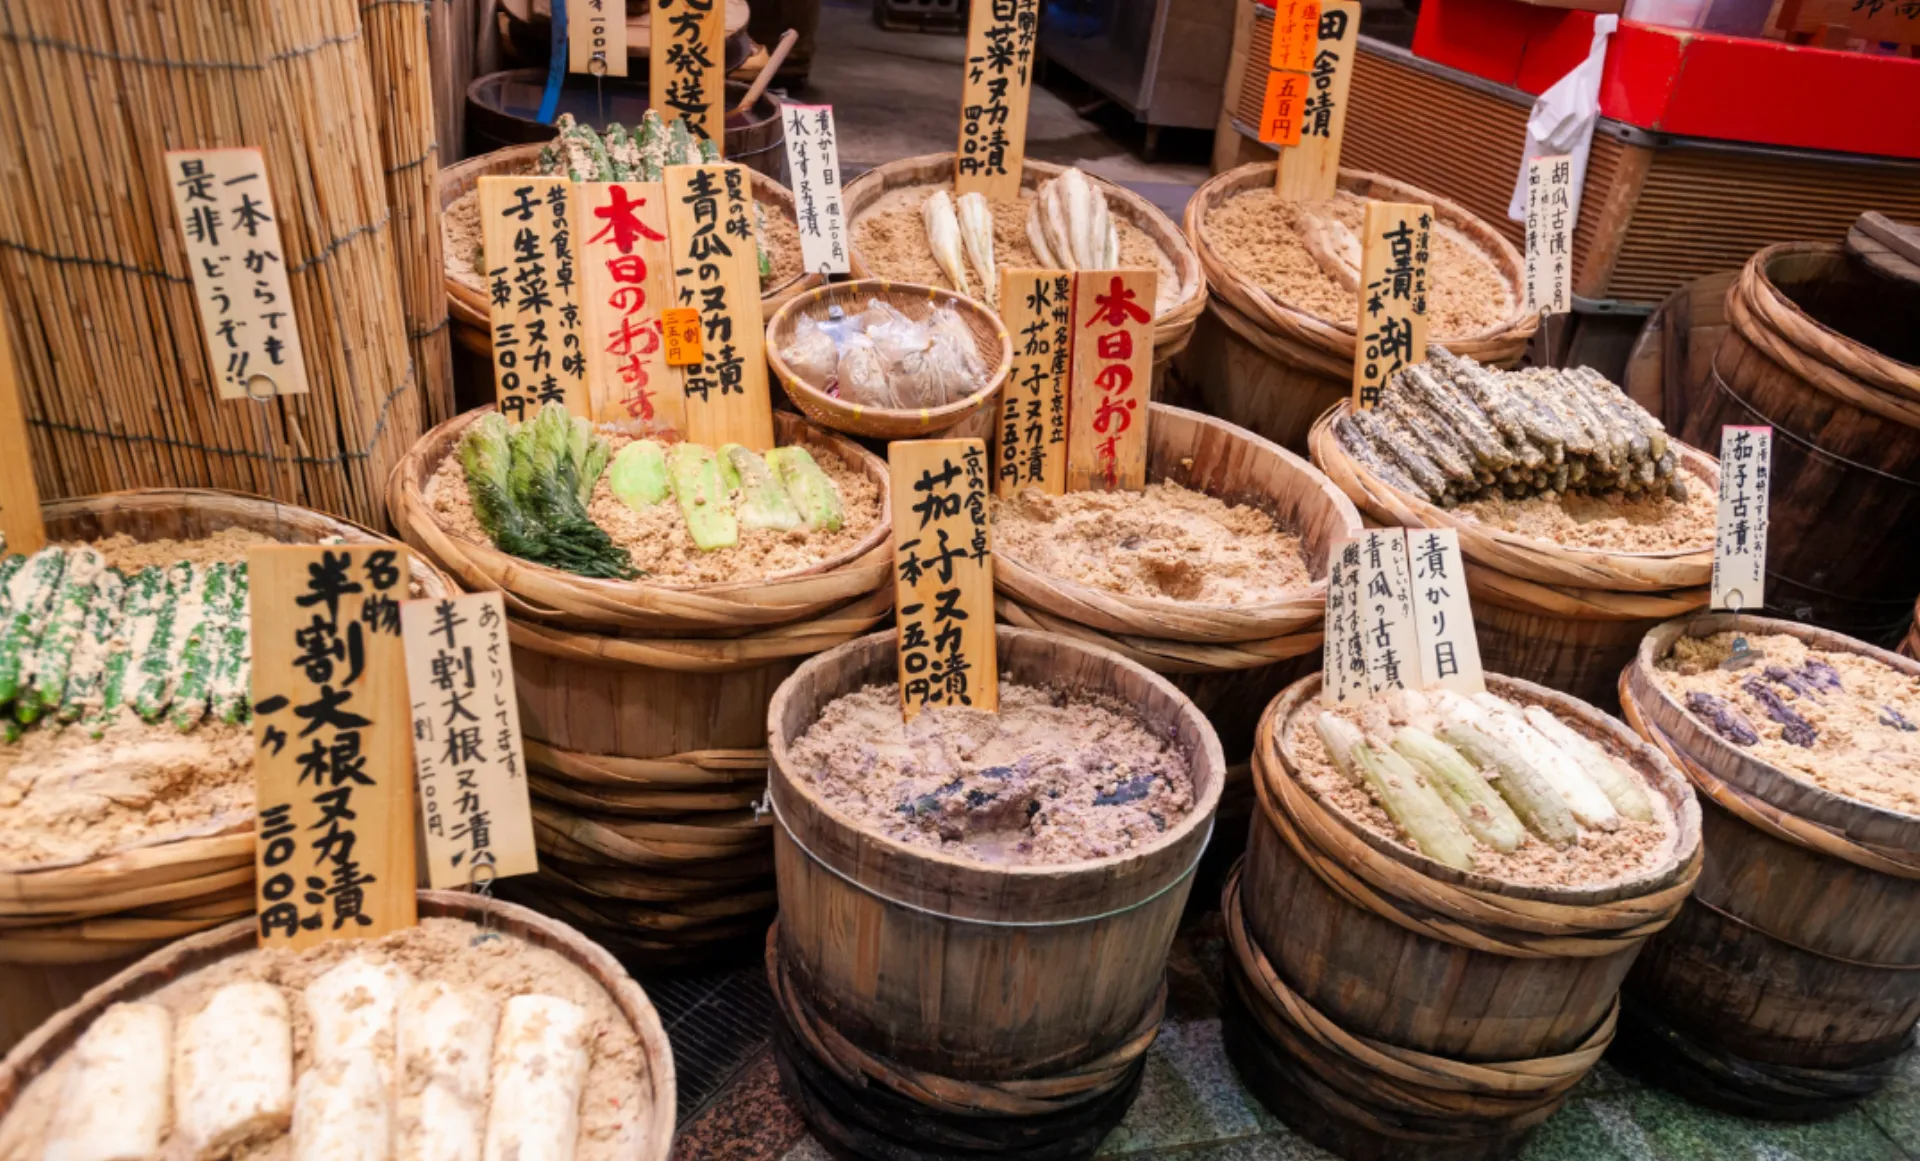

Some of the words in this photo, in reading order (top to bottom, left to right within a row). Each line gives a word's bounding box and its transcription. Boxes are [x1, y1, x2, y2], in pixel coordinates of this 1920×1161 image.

[1271, 78, 1299, 139] 五百円
[1301, 9, 1348, 138] 田舎漬
[724, 168, 754, 241] 夏の味
[961, 446, 990, 568] 京の食卓
[361, 549, 402, 636] 名物
[1416, 533, 1459, 679] 漬かり目
